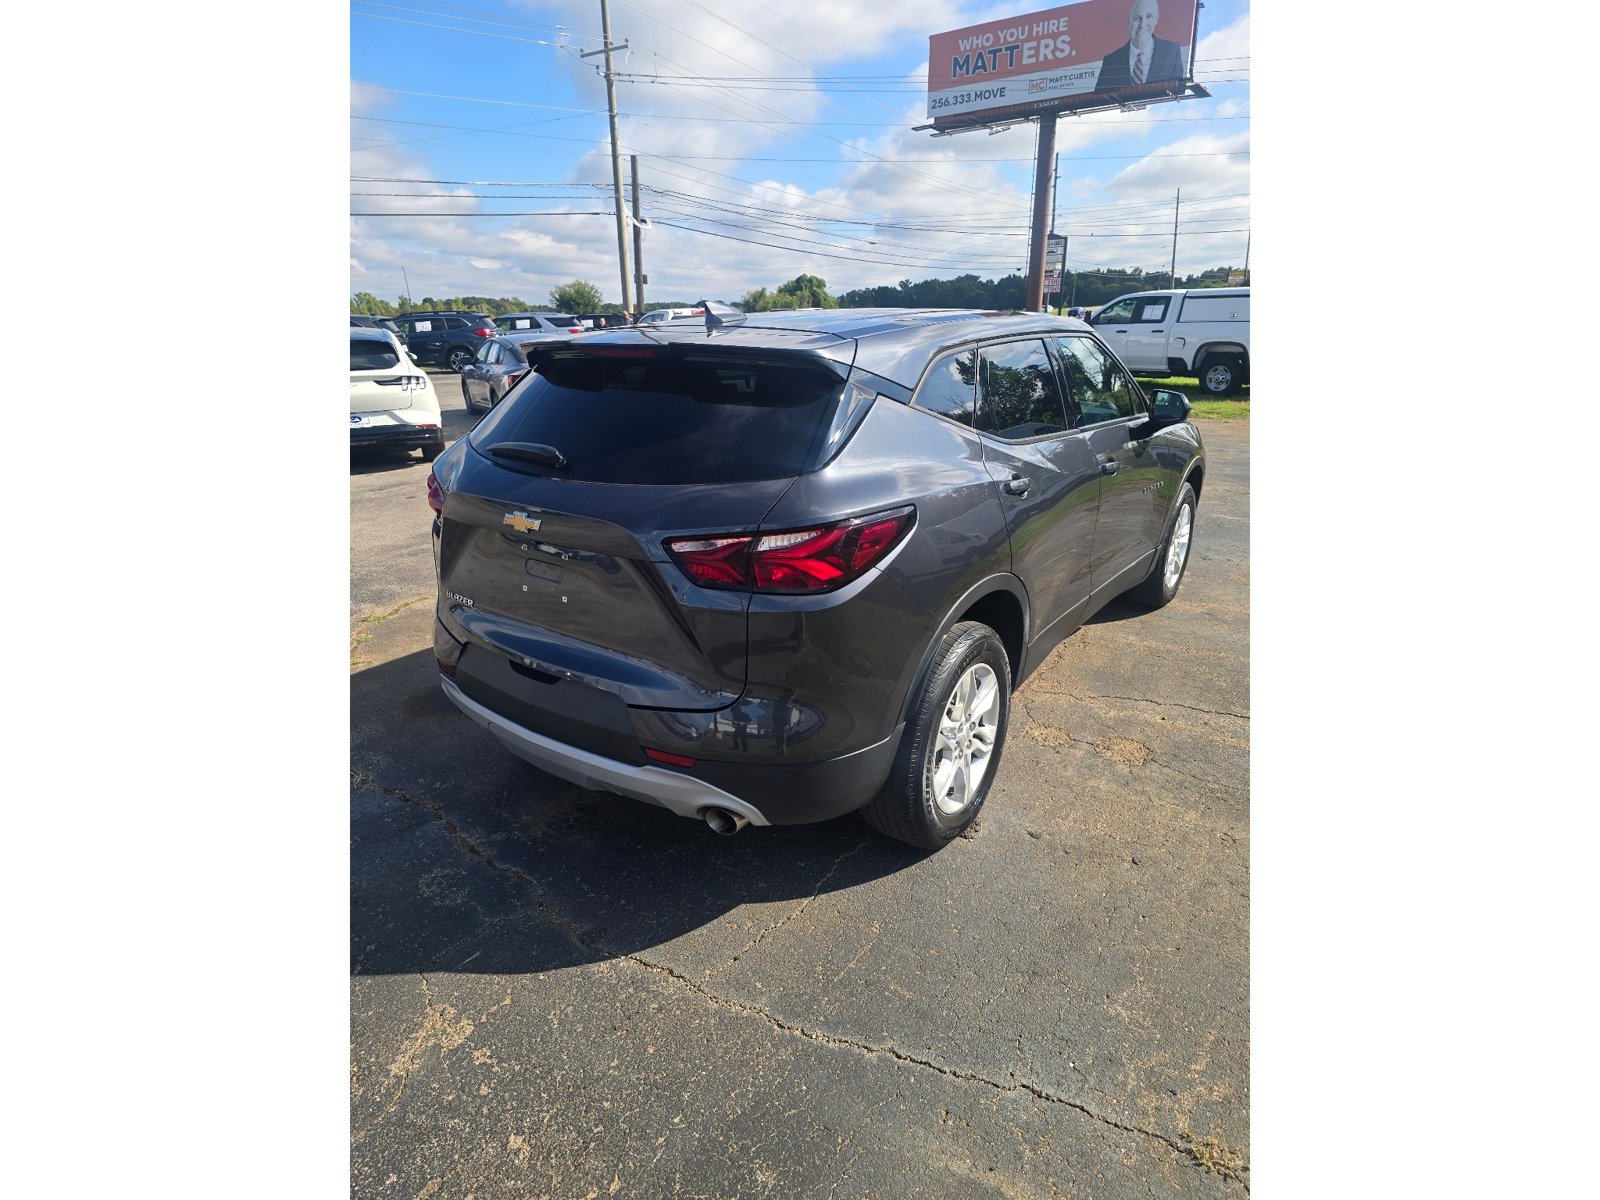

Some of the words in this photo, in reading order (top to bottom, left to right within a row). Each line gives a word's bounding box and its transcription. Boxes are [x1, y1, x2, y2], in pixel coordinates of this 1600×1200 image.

[958, 33, 994, 51] WHO
[997, 25, 1029, 44] YOU
[1032, 17, 1069, 37] HIRE
[951, 34, 1077, 80] MATTERS.
[931, 86, 1007, 109] 256.333.MOVE
[1030, 80, 1046, 92] MC
[446, 589, 474, 608] BLAZER
